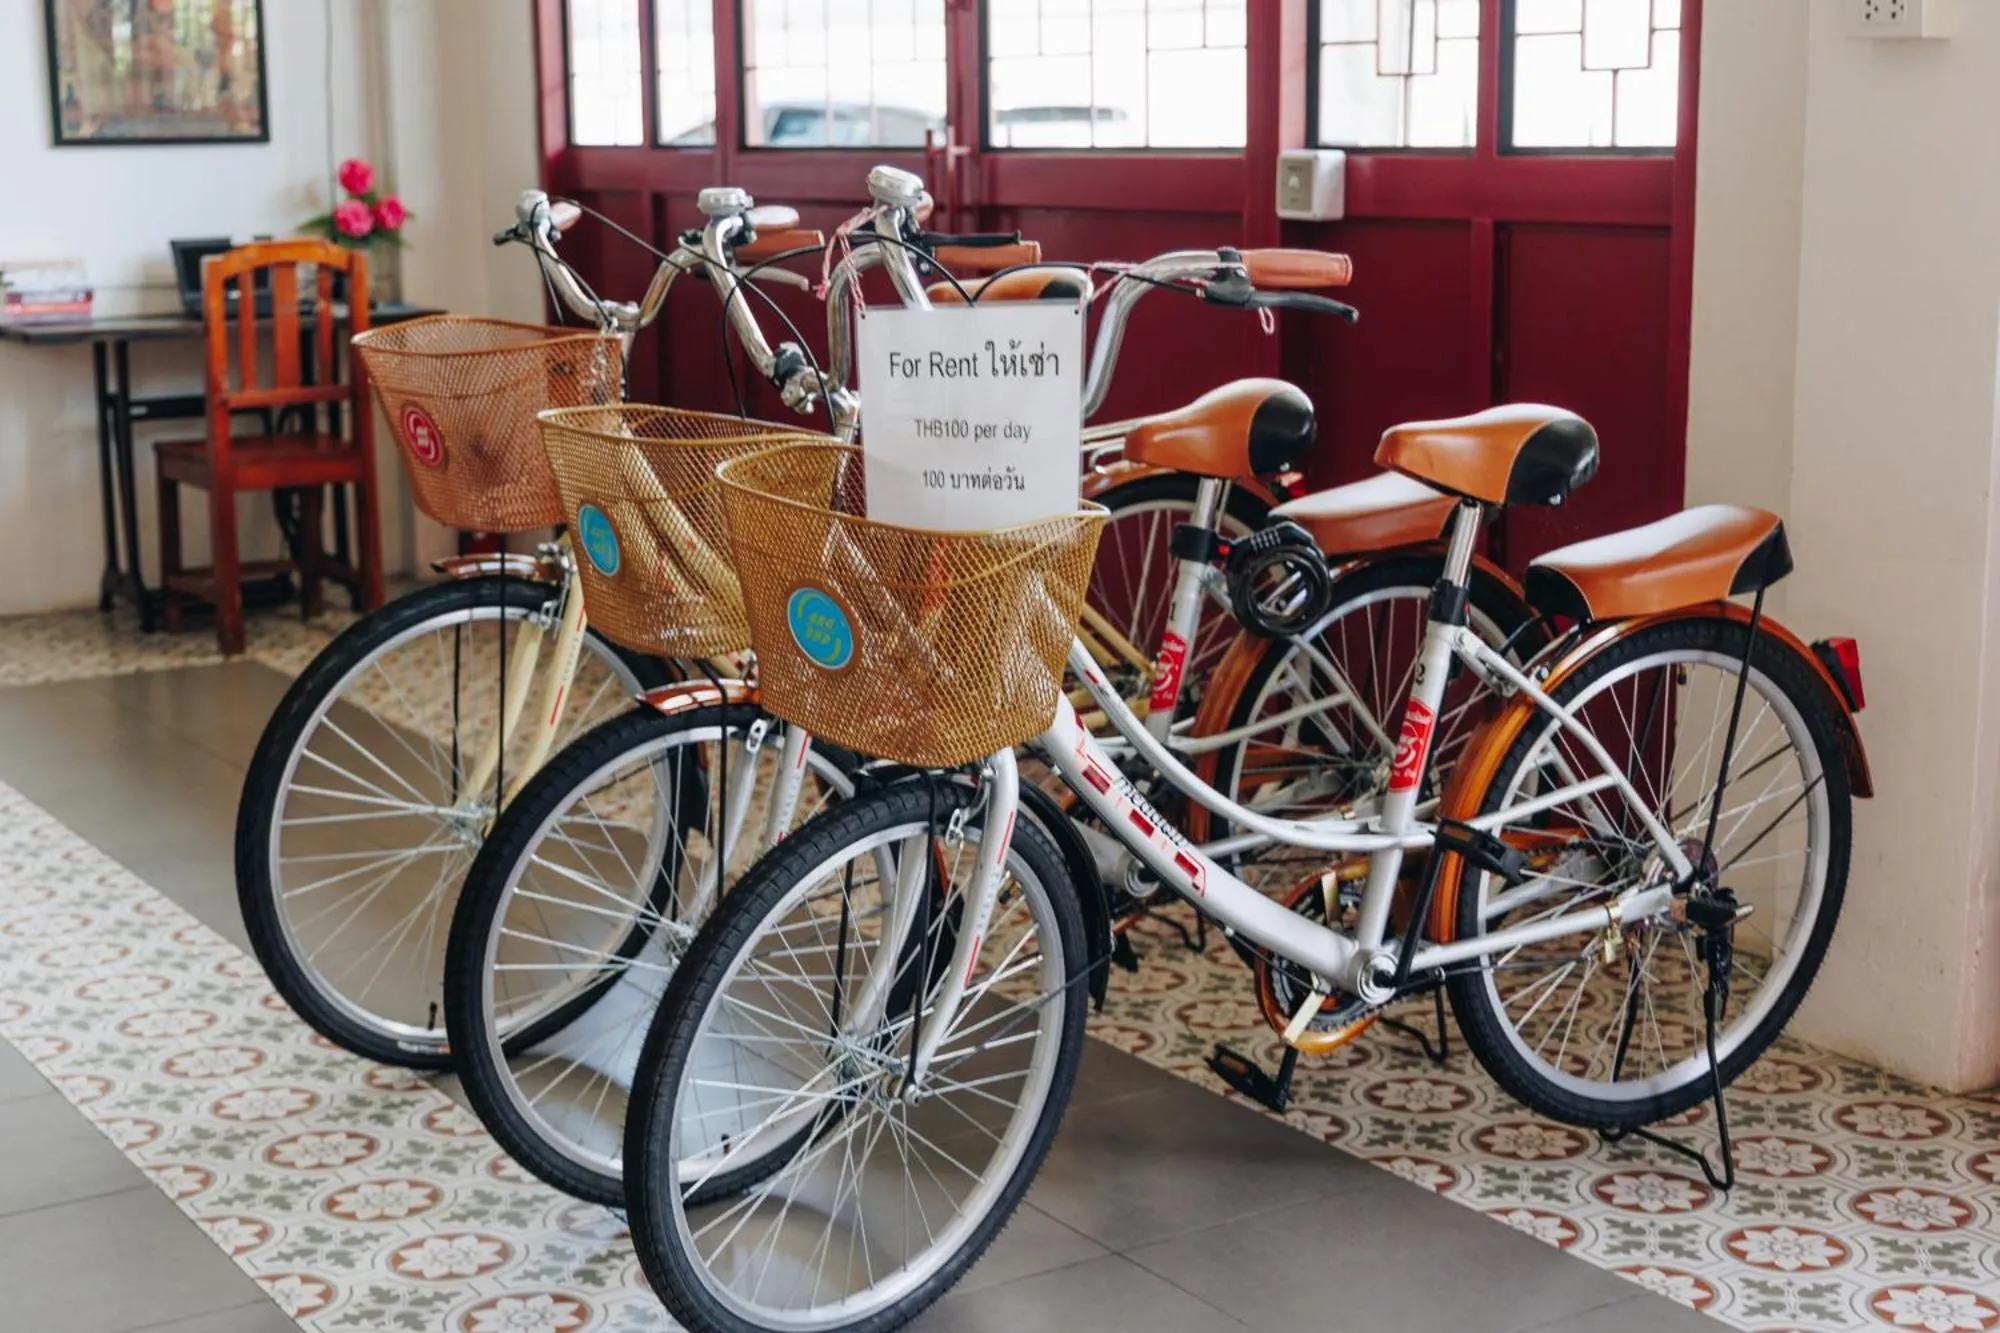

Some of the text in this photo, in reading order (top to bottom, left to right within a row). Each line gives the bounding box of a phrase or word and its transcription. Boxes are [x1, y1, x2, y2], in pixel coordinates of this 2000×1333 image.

[889, 338, 1060, 378] For Rent ให้เช่า
[914, 418, 1032, 443] THB100 per day
[922, 464, 1026, 491] 100 บาทต่อวัน
